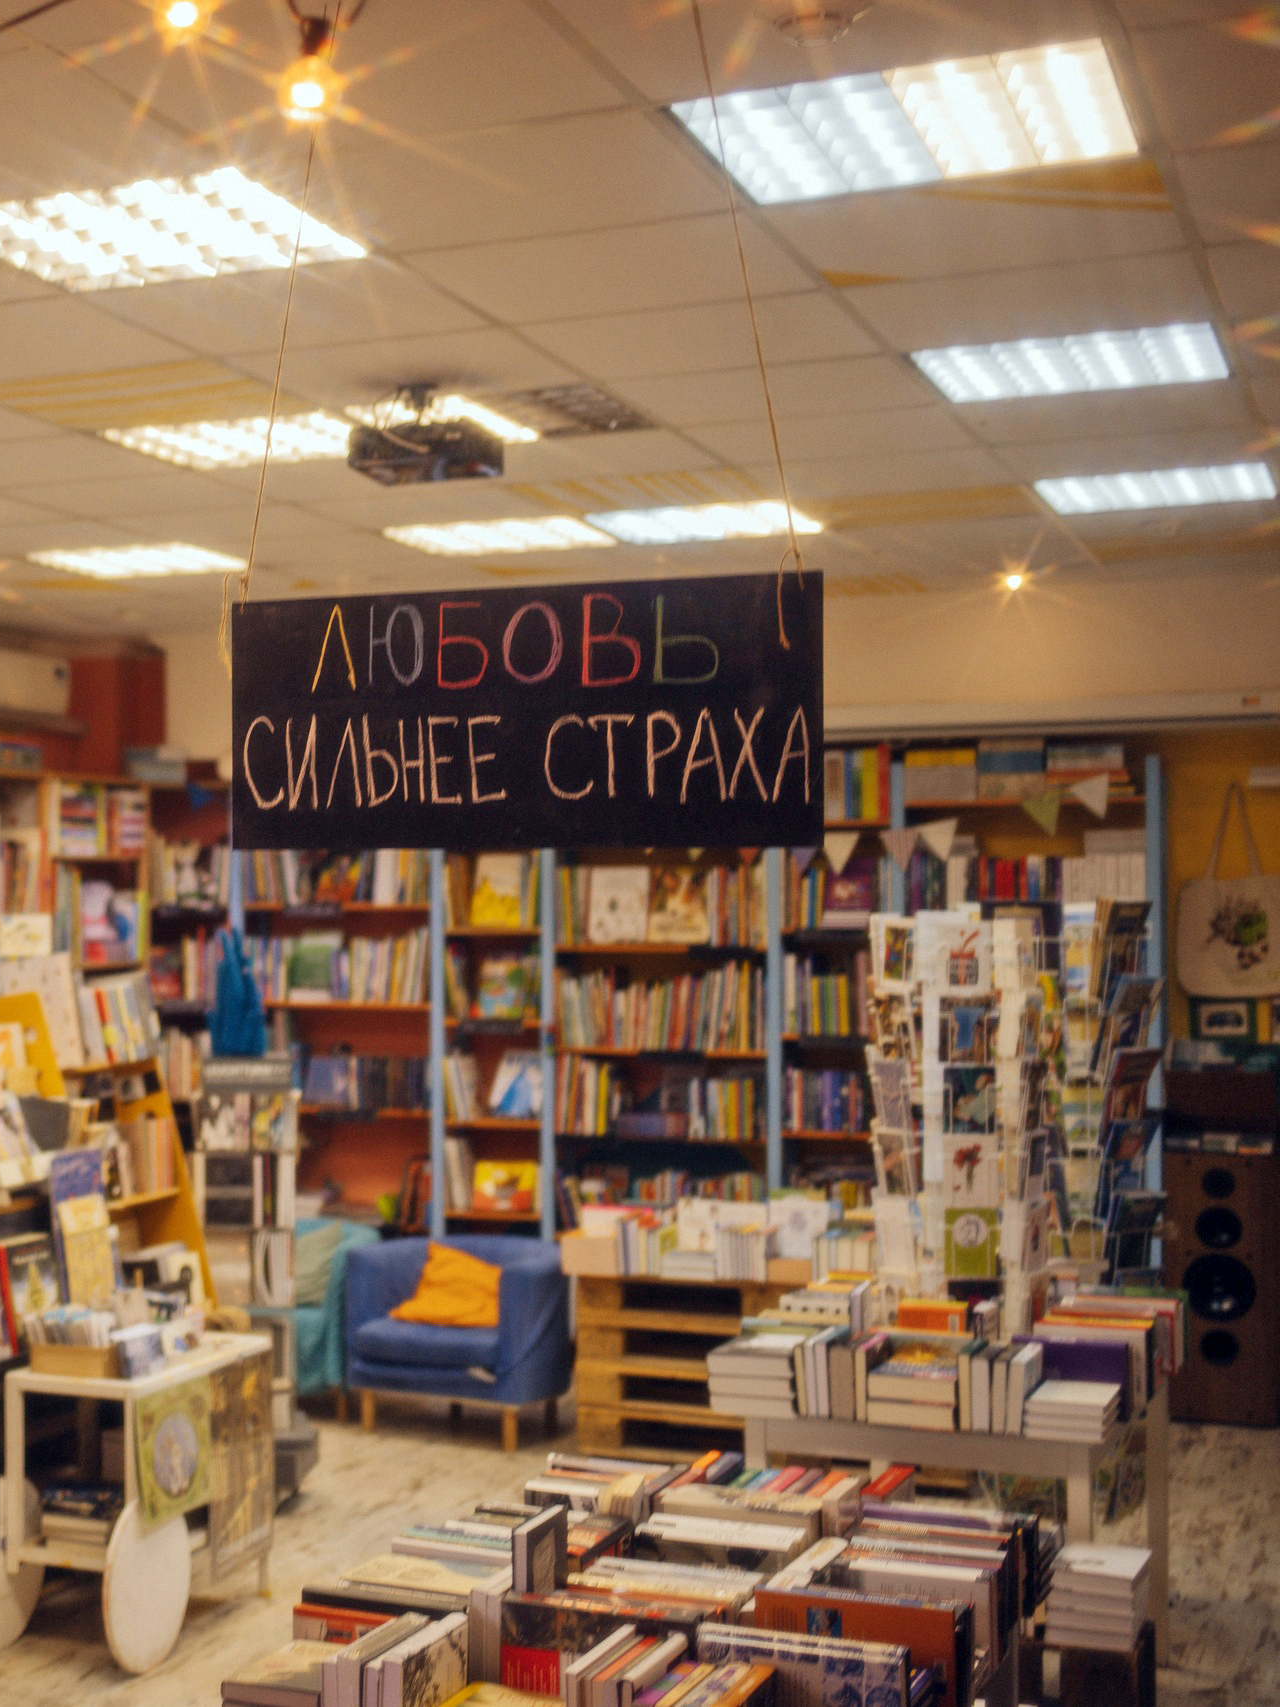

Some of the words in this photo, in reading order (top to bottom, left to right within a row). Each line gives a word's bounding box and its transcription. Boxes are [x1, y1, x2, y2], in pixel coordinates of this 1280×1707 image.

[311, 592, 720, 691] ЛЮБОВЬ
[243, 713, 507, 811] СИЛЬНЕЕ
[544, 704, 810, 805] СТРАХА
